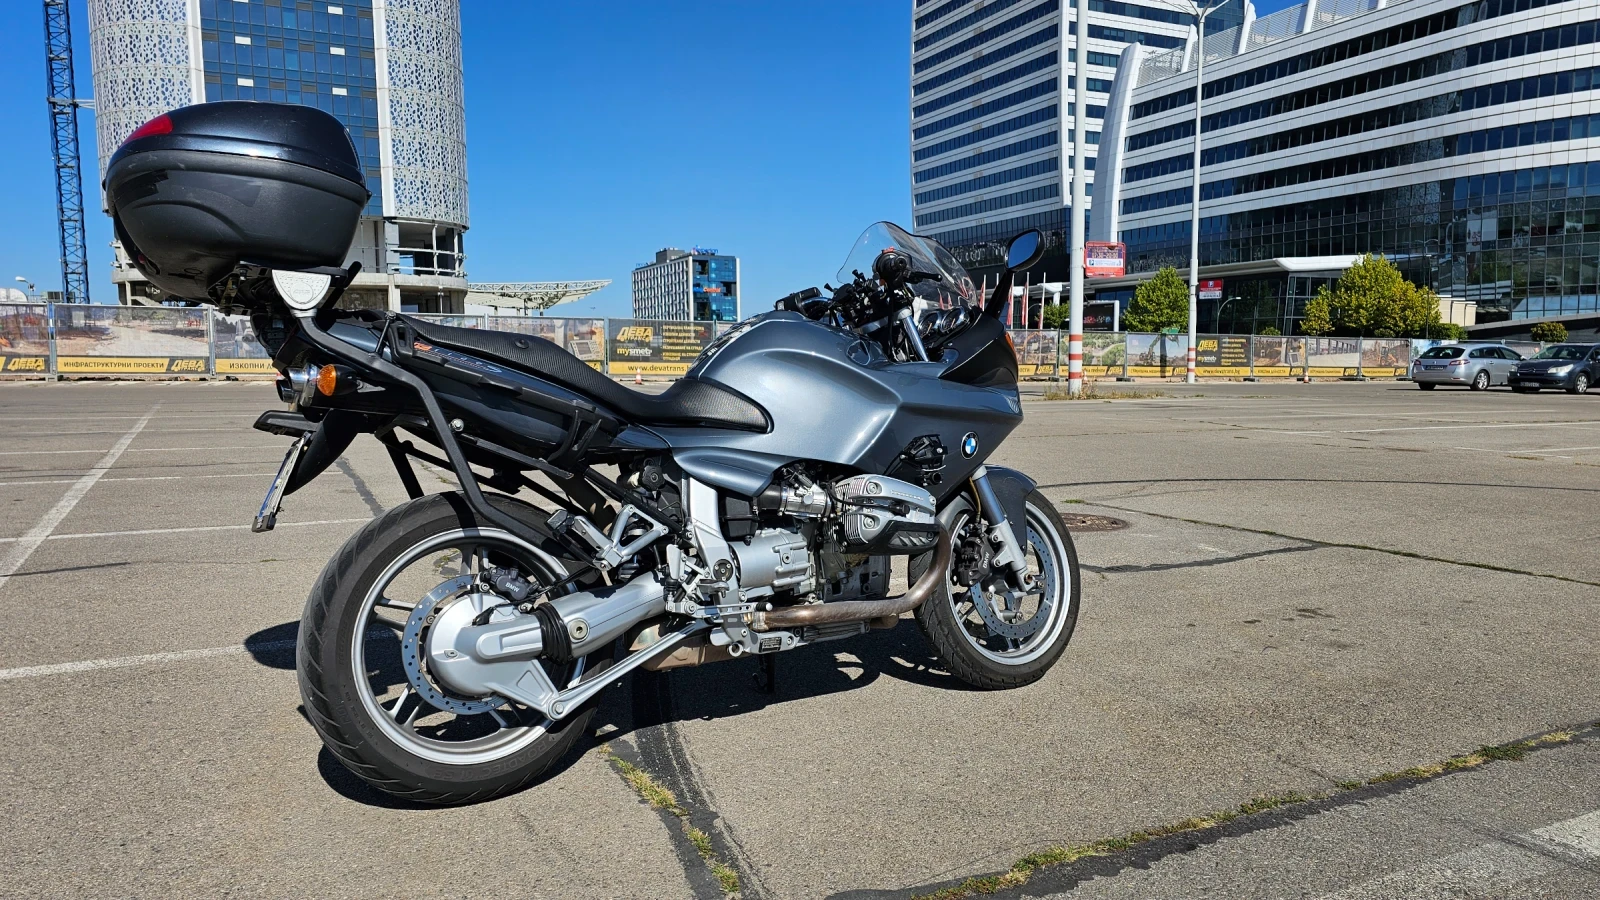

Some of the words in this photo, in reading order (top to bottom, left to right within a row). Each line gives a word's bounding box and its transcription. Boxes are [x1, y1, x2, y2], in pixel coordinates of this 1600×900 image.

[616, 326, 653, 342] ДЕВА
[63, 361, 132, 369] ИНФРАСТРУКТУРНИ
[982, 551, 990, 569] BMW
[505, 582, 520, 593] BMW
